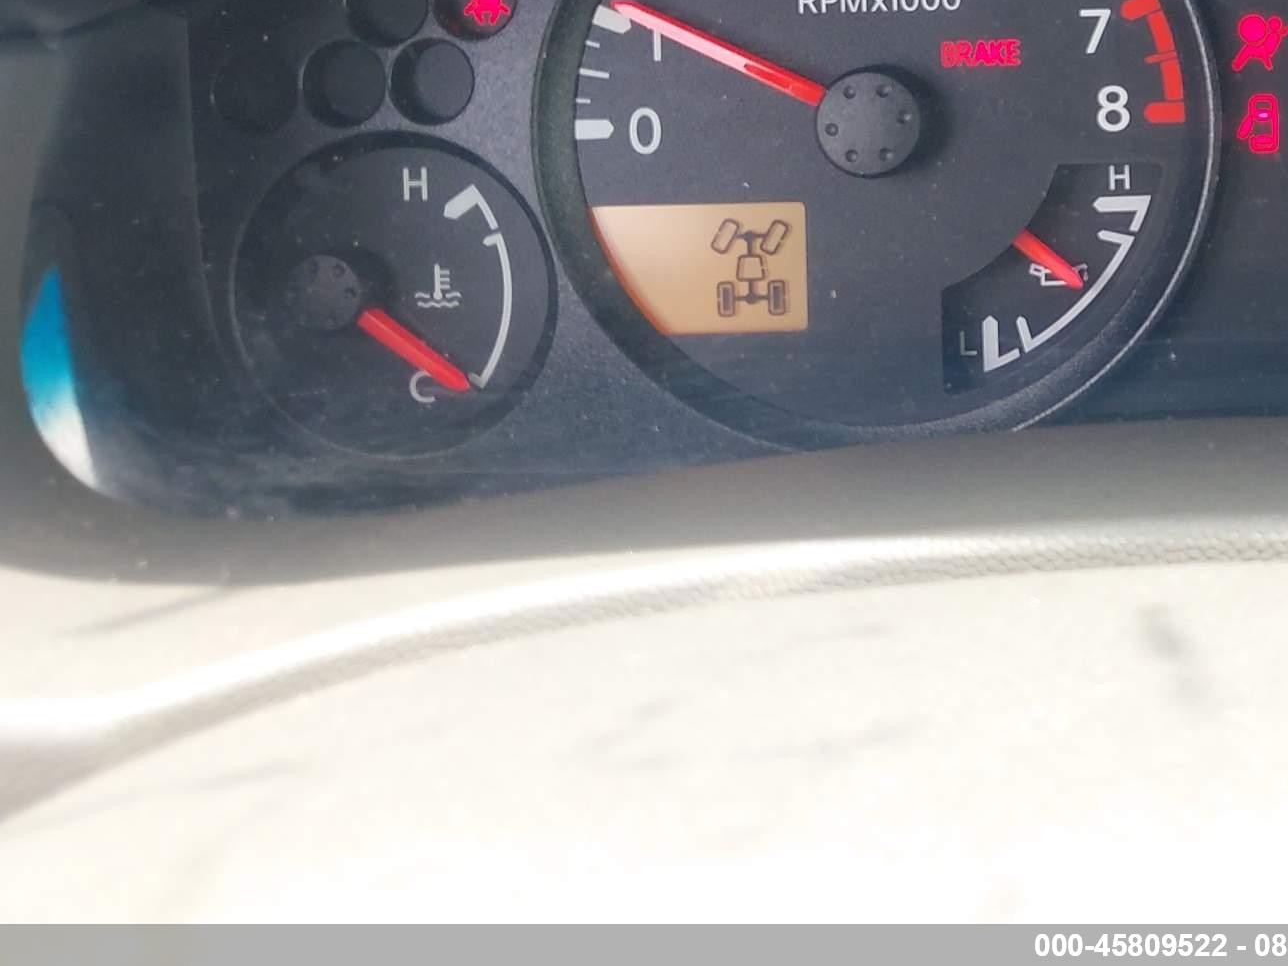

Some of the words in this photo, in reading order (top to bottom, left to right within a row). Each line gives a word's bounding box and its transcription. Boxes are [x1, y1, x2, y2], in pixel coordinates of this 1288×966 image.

[1080, 9, 1111, 53] 7
[941, 38, 1022, 68] BRAKE
[1098, 86, 1130, 131] 8
[630, 108, 661, 154] 0
[403, 167, 428, 201] H
[1110, 165, 1130, 190] H
[960, 331, 977, 355] L
[409, 370, 437, 403] C
